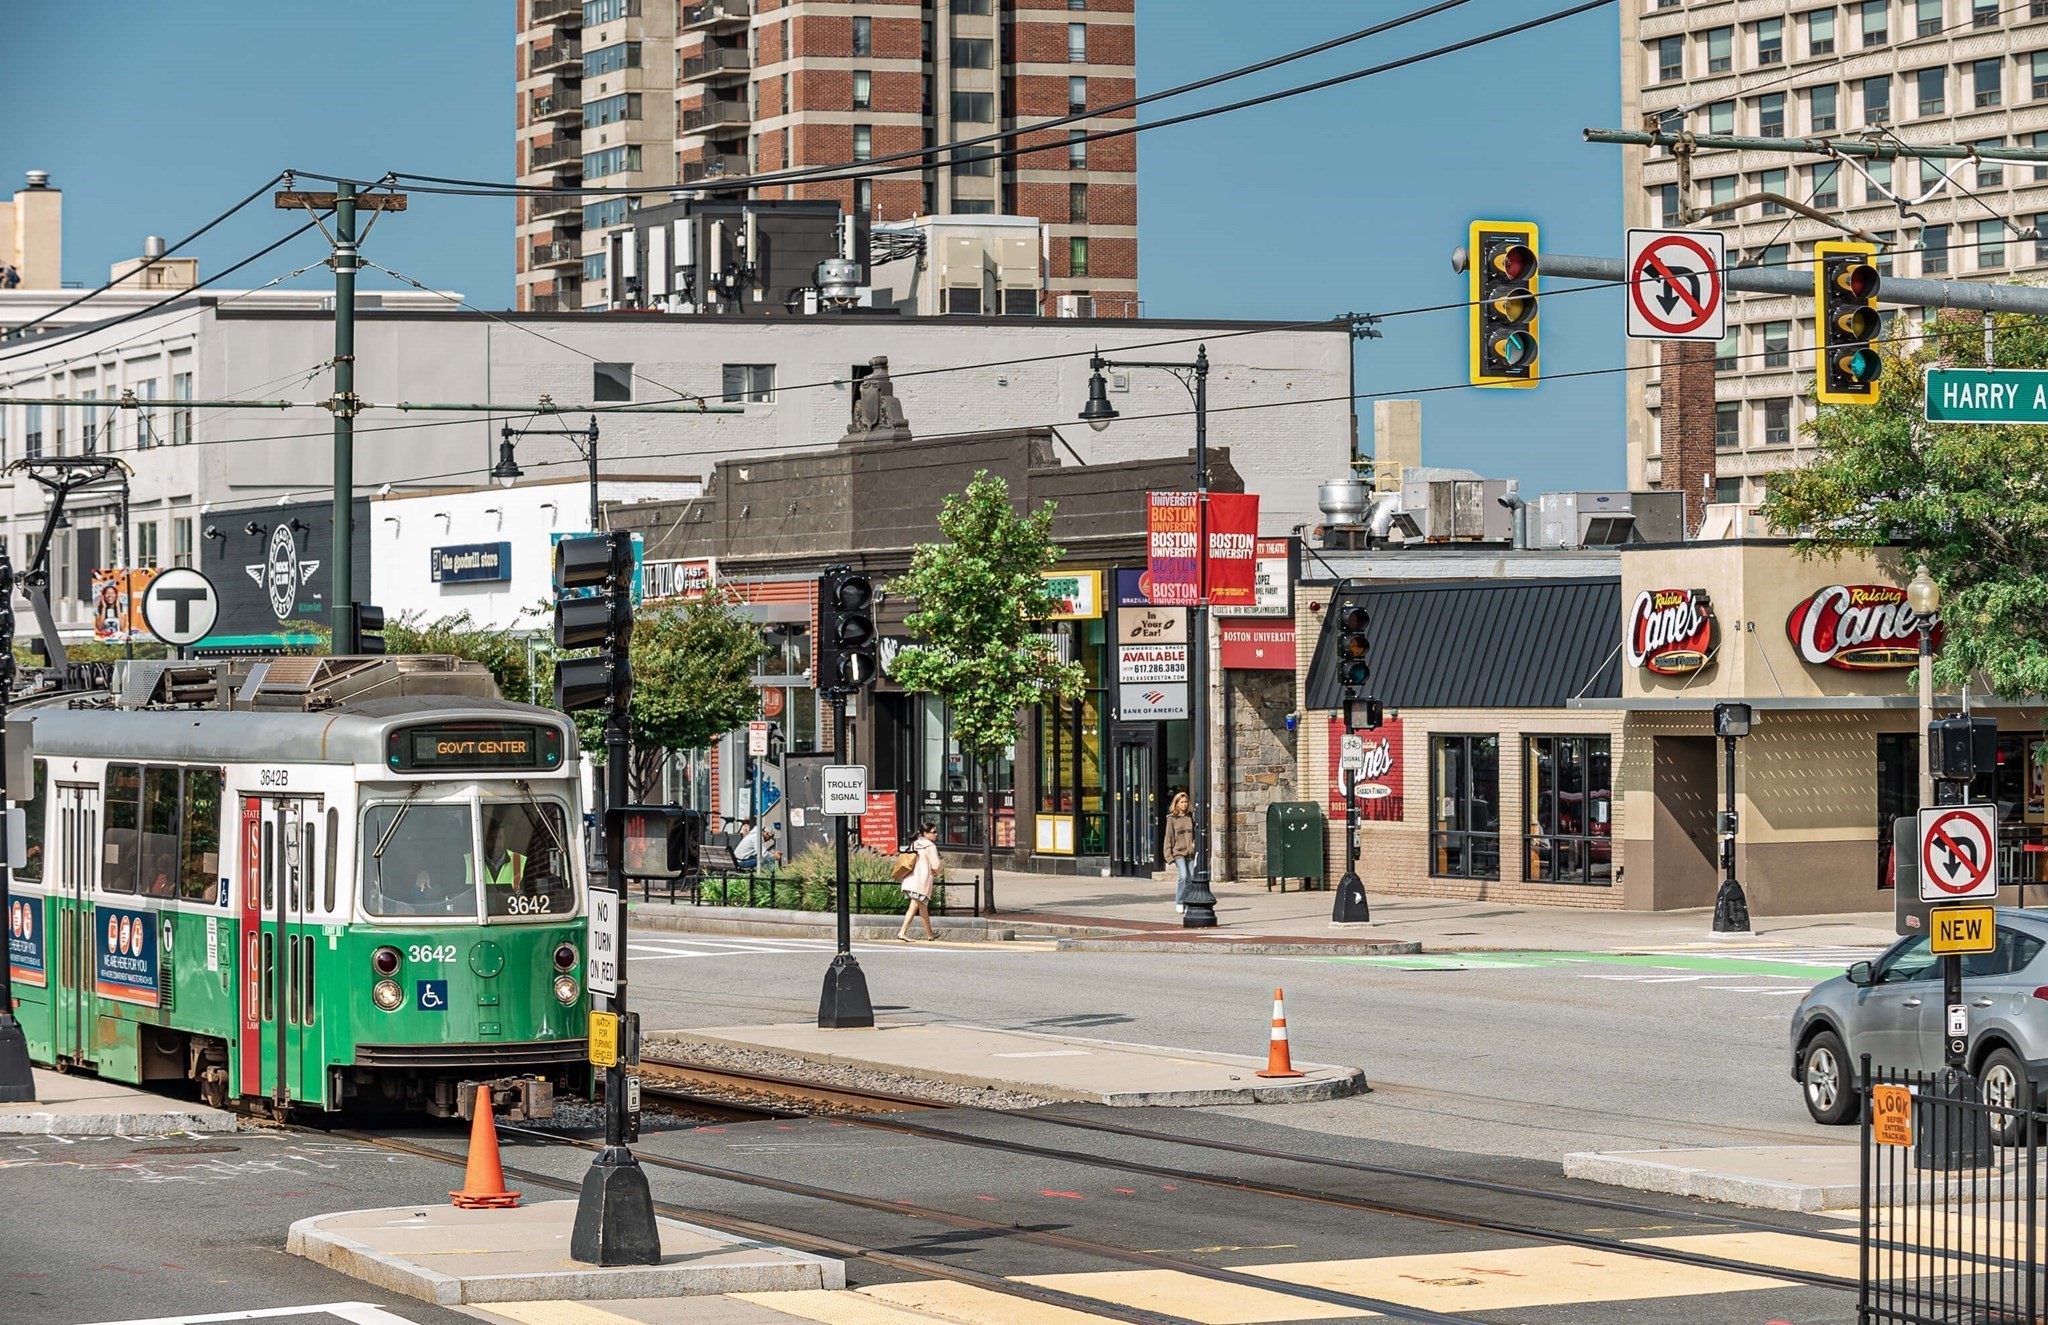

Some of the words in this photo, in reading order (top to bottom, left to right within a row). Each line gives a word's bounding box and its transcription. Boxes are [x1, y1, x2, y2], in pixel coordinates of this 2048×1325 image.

[1943, 382, 2019, 409] HARRY
[1151, 496, 1197, 506] UNIVERSITY
[1151, 507, 1197, 521] BOSTON
[1151, 522, 1197, 532] UNIVERSITY
[1151, 532, 1197, 547] BOSTON
[1209, 533, 1255, 549] BOSTON
[1151, 547, 1197, 558] UNIVERSITY
[1209, 548, 1254, 559] UNIVERSITY
[1152, 558, 1197, 572] BOSTON
[1152, 583, 1198, 598] BOSTON
[1851, 588, 1902, 605] Raising
[1655, 592, 1682, 610] Raising
[156, 588, 207, 633] T
[1147, 611, 1157, 620] In
[1141, 620, 1162, 628] Your
[1626, 589, 1702, 668] Cane's
[1142, 628, 1161, 637] Ear!
[1223, 631, 1251, 642] BOSTON
[1253, 631, 1296, 642] UNIVERSITY
[1122, 651, 1185, 662] AVAILABLE
[1134, 664, 1186, 673] 617.286.3830
[437, 741, 475, 753] GOV'T
[477, 741, 526, 753] CENTER
[260, 769, 289, 786] 3642B
[827, 780, 863, 789] TROLLEY
[830, 793, 860, 801] SIGNAL
[243, 809, 260, 819] STATE
[507, 894, 551, 914] 3642
[597, 901, 609, 922] NO
[1941, 919, 1982, 941] NEW
[594, 931, 611, 952] TURN
[408, 945, 457, 962] 3642
[590, 958, 600, 979] ON
[602, 960, 614, 982] RED
[595, 1017, 611, 1028] WATCH
[598, 1028, 608, 1038] FOR
[594, 1038, 612, 1049] TURNING
[593, 1049, 613, 1060] VEHICLES
[1877, 1094, 1909, 1119] LOOK
